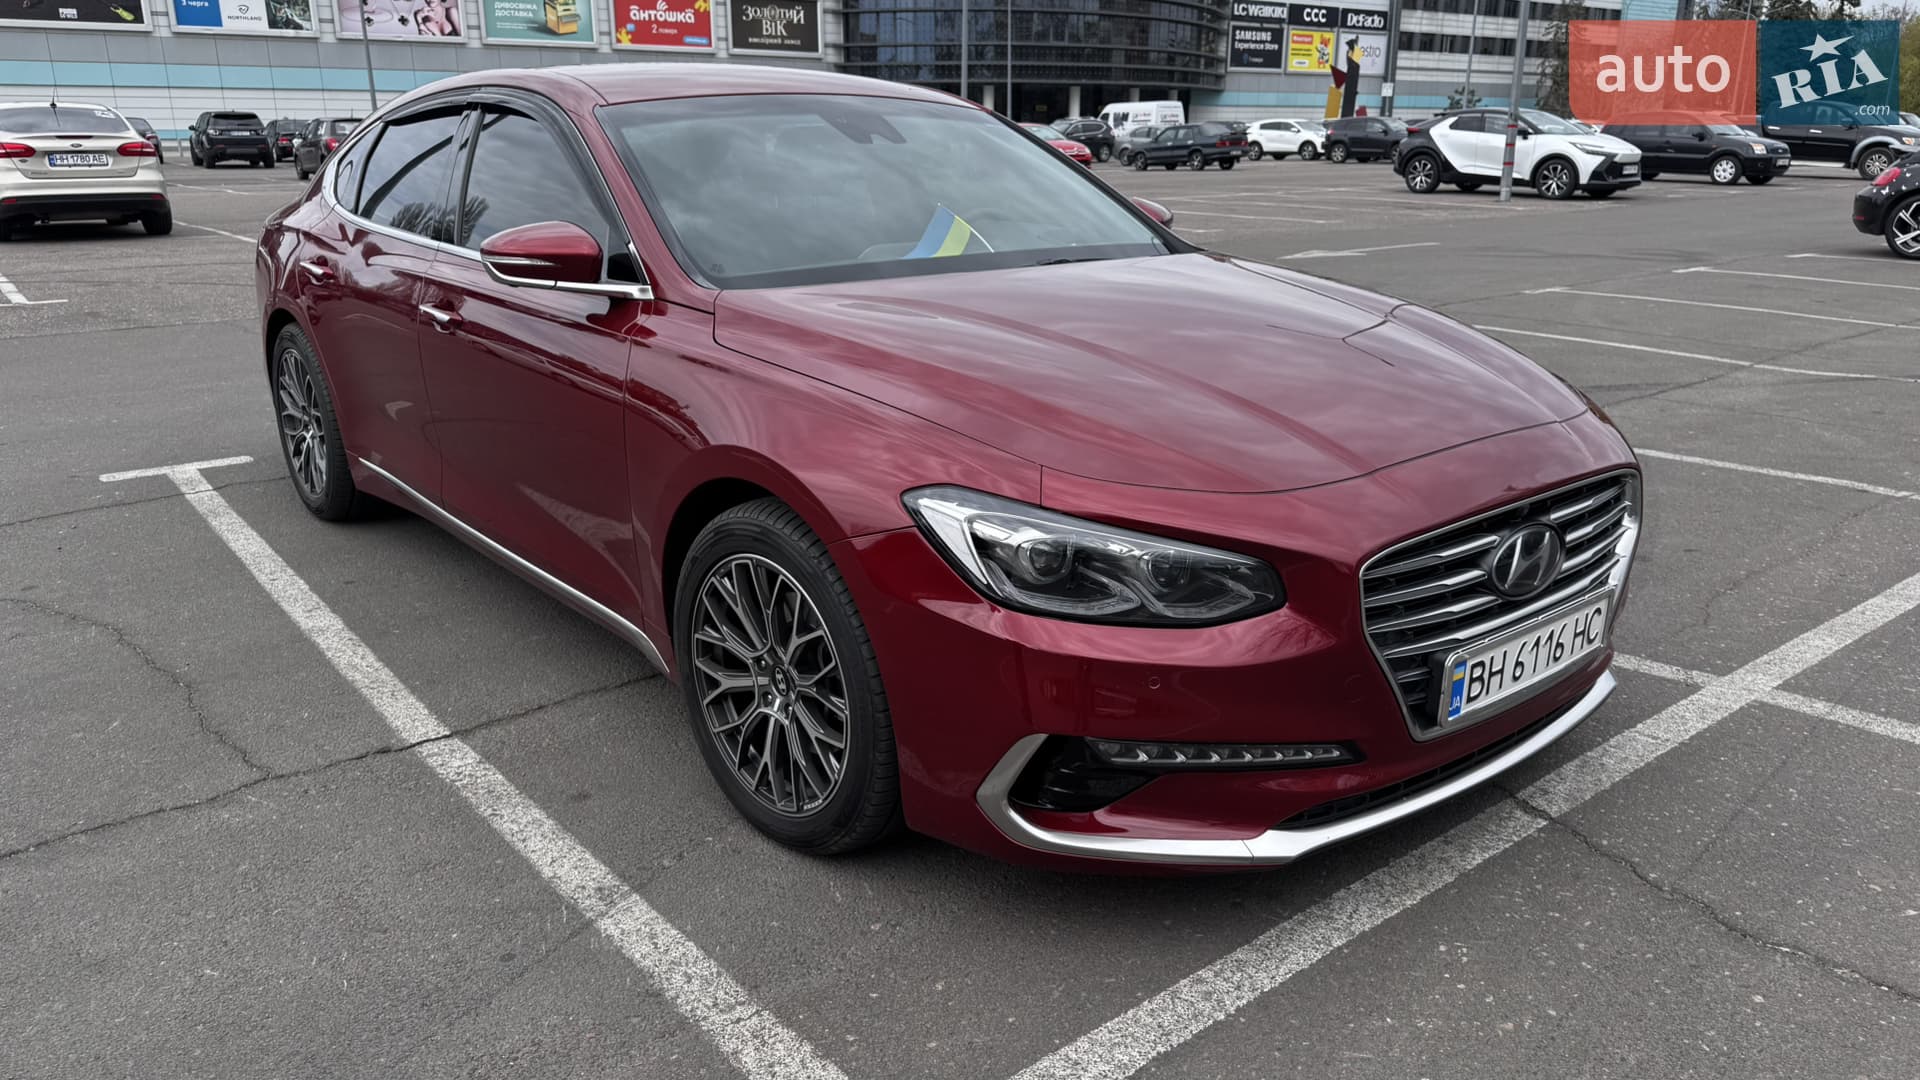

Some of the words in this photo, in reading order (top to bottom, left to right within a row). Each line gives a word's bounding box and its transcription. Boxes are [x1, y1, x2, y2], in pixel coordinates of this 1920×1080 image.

[495, 9, 533, 17] ДОСТАВКА
[1233, 3, 1248, 16] LC
[1303, 8, 1327, 22] CCC
[1347, 13, 1384, 28] DeFacto
[651, 23, 658, 34] 2
[1235, 30, 1273, 42] SAMSUNG
[1235, 41, 1264, 51] Experience
[1466, 650, 1508, 705] BH
[1512, 622, 1568, 682] 6116
[1570, 606, 1602, 656] HC
